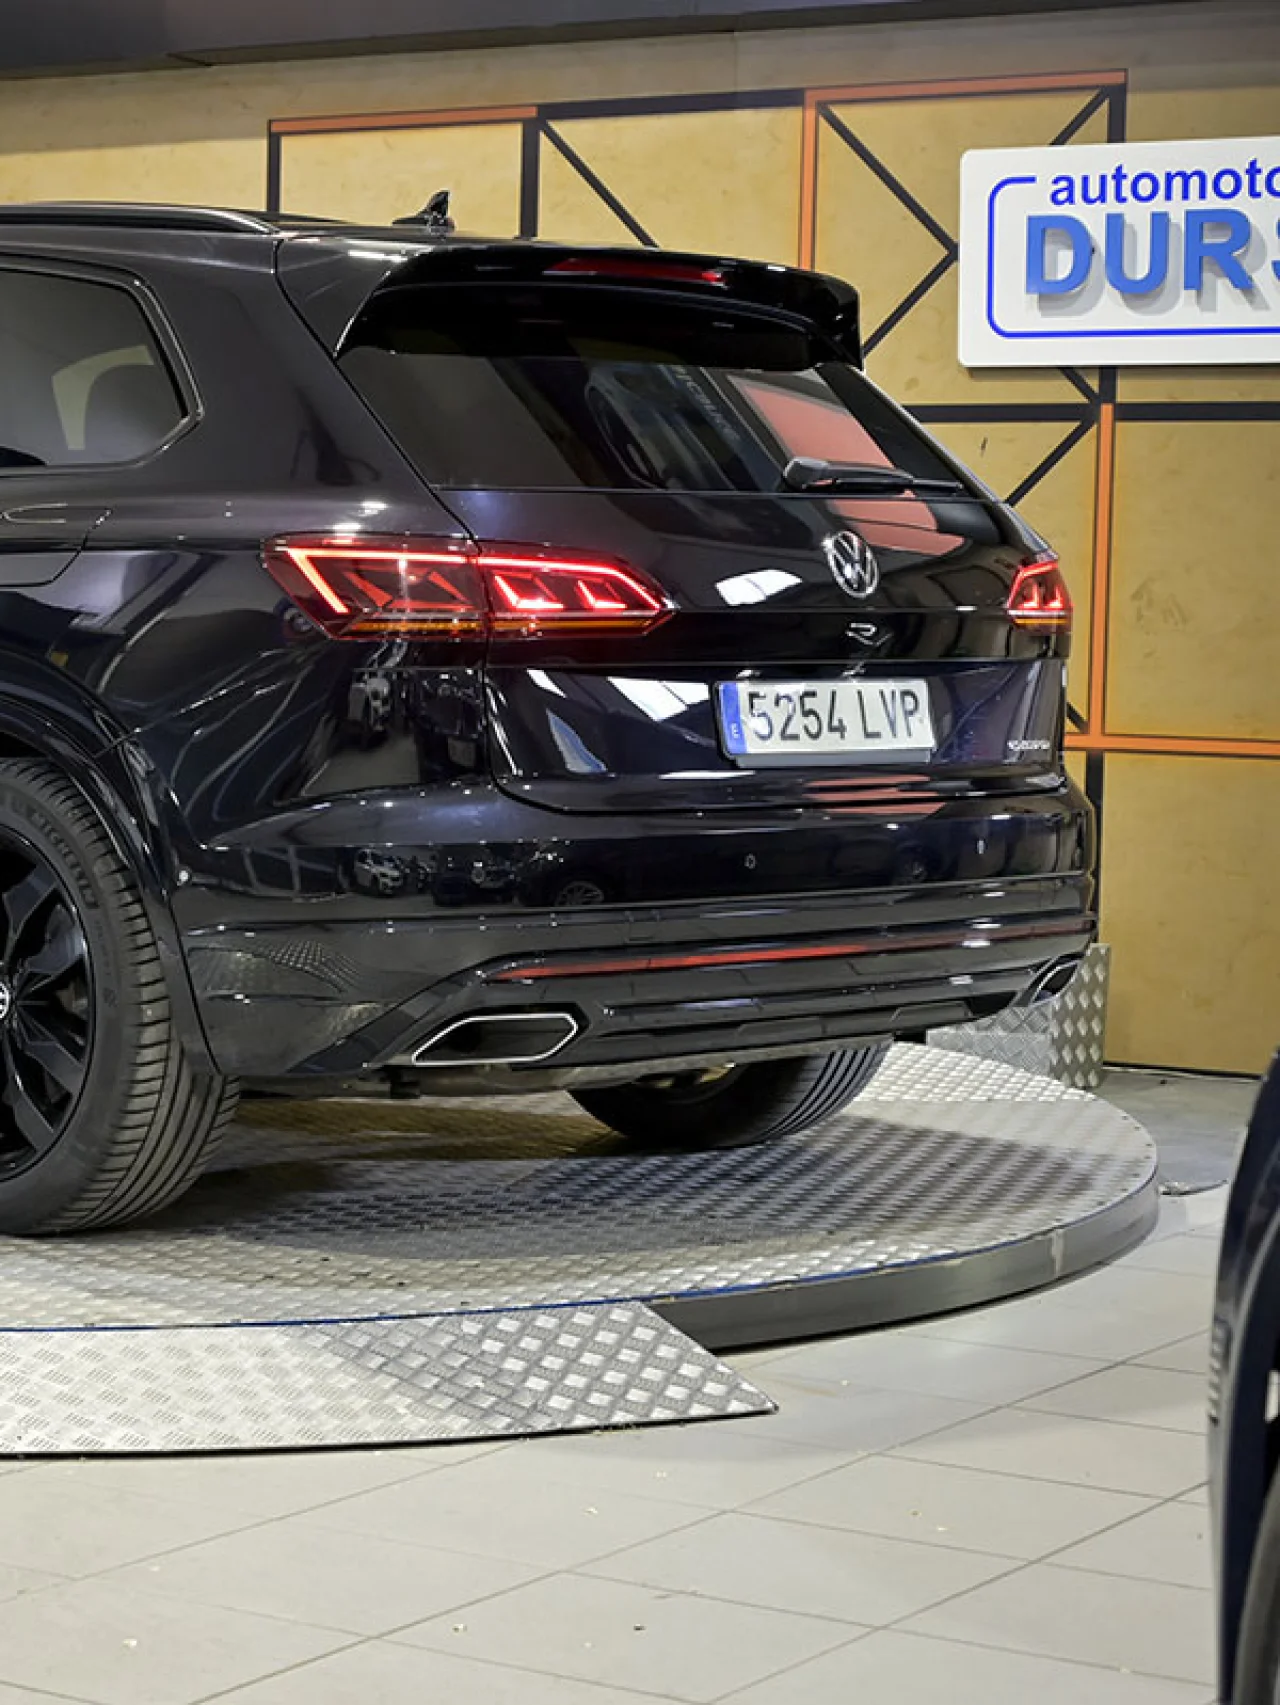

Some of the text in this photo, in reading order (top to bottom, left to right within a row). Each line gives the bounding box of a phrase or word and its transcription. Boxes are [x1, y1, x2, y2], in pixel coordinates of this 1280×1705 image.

[1025, 208, 1280, 295] DUR
[747, 688, 920, 741] 5254 LVP
